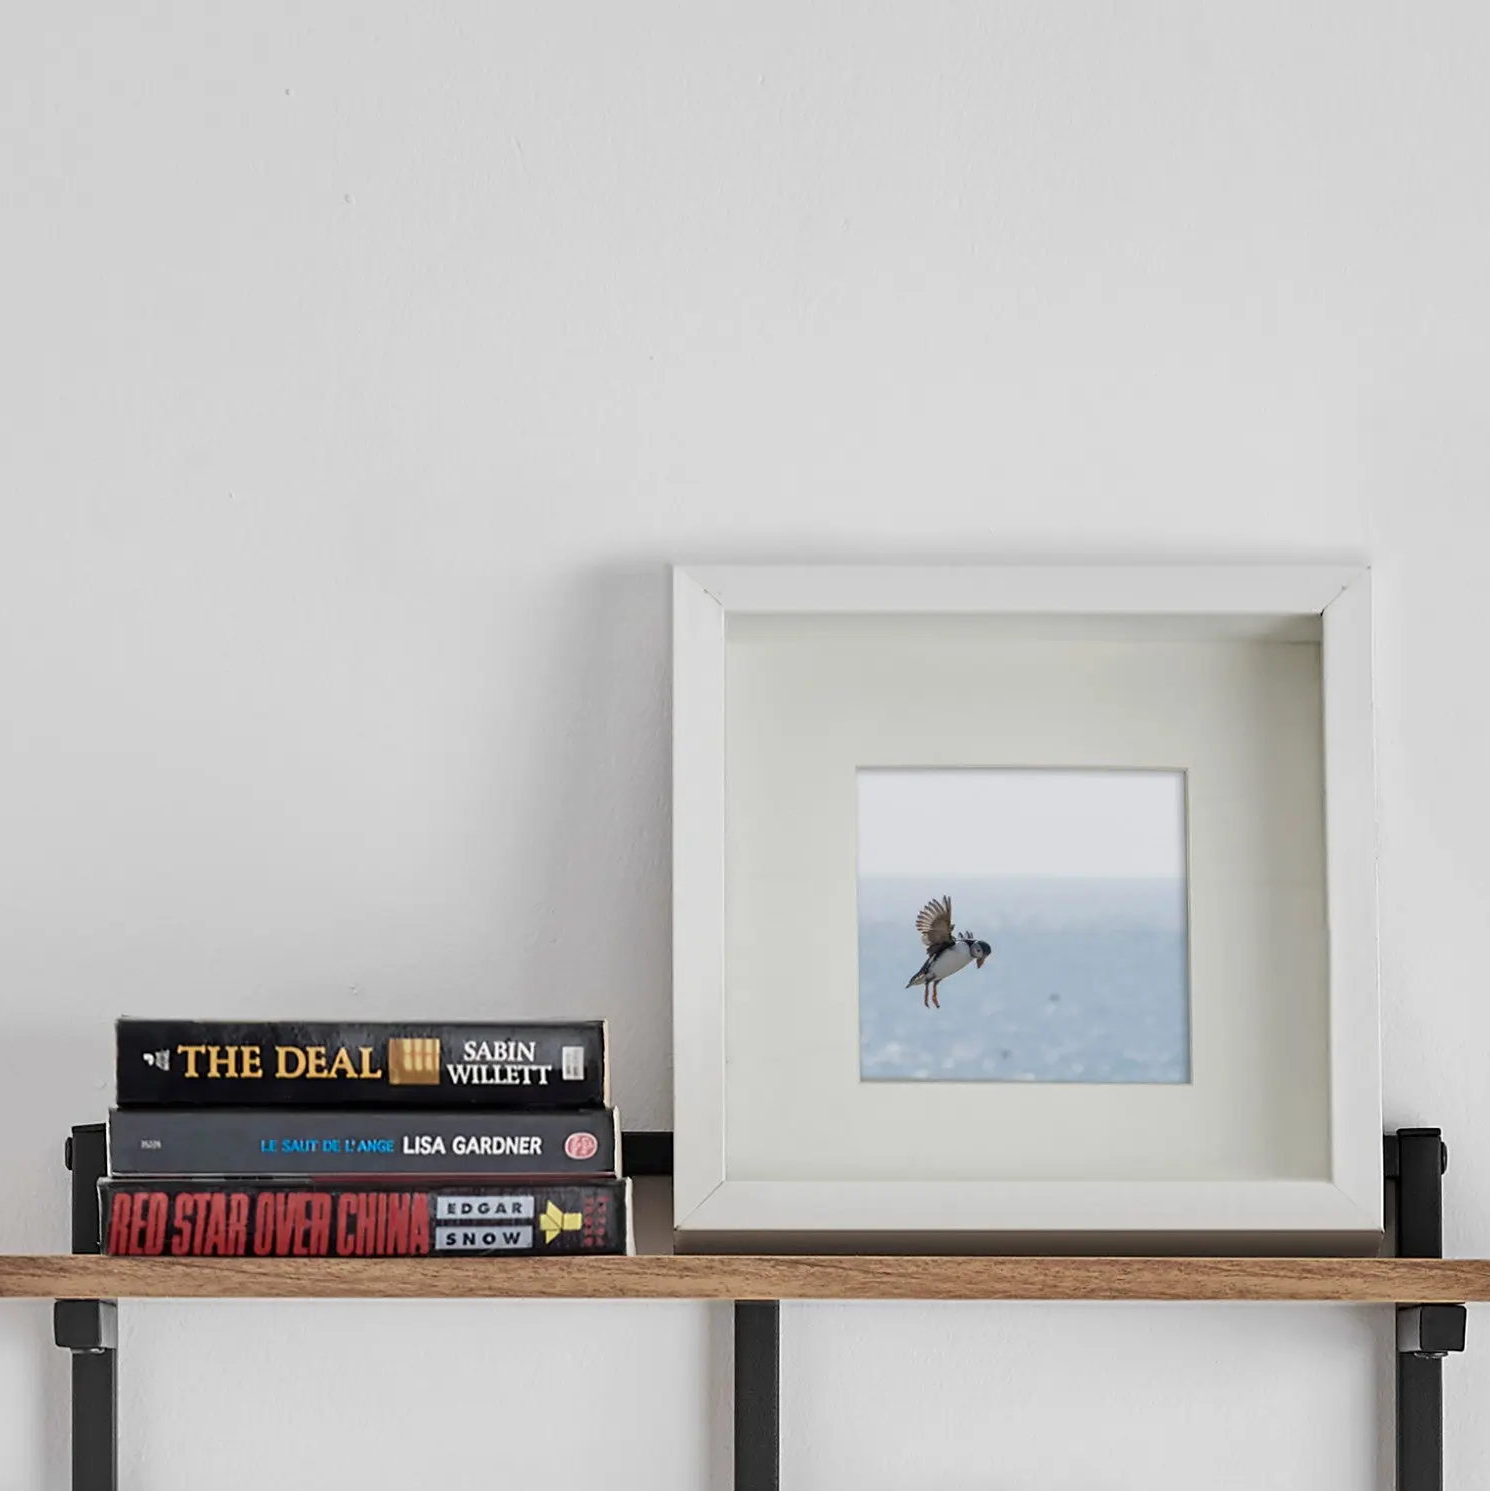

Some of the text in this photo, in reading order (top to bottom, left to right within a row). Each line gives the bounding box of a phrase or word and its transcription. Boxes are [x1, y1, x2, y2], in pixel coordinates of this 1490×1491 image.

[463, 1041, 536, 1062] SABIN
[177, 1045, 382, 1079] THE DEAL
[446, 1064, 552, 1085] WILLETT
[261, 1139, 277, 1152] LE
[282, 1139, 318, 1152] SAUT
[322, 1139, 341, 1152] DE
[403, 1136, 542, 1155] LISA GARDNER
[447, 1202, 523, 1215] EDGAR
[109, 1191, 430, 1256] RED STAR OVER CHINA
[445, 1232, 522, 1247] SNOW
